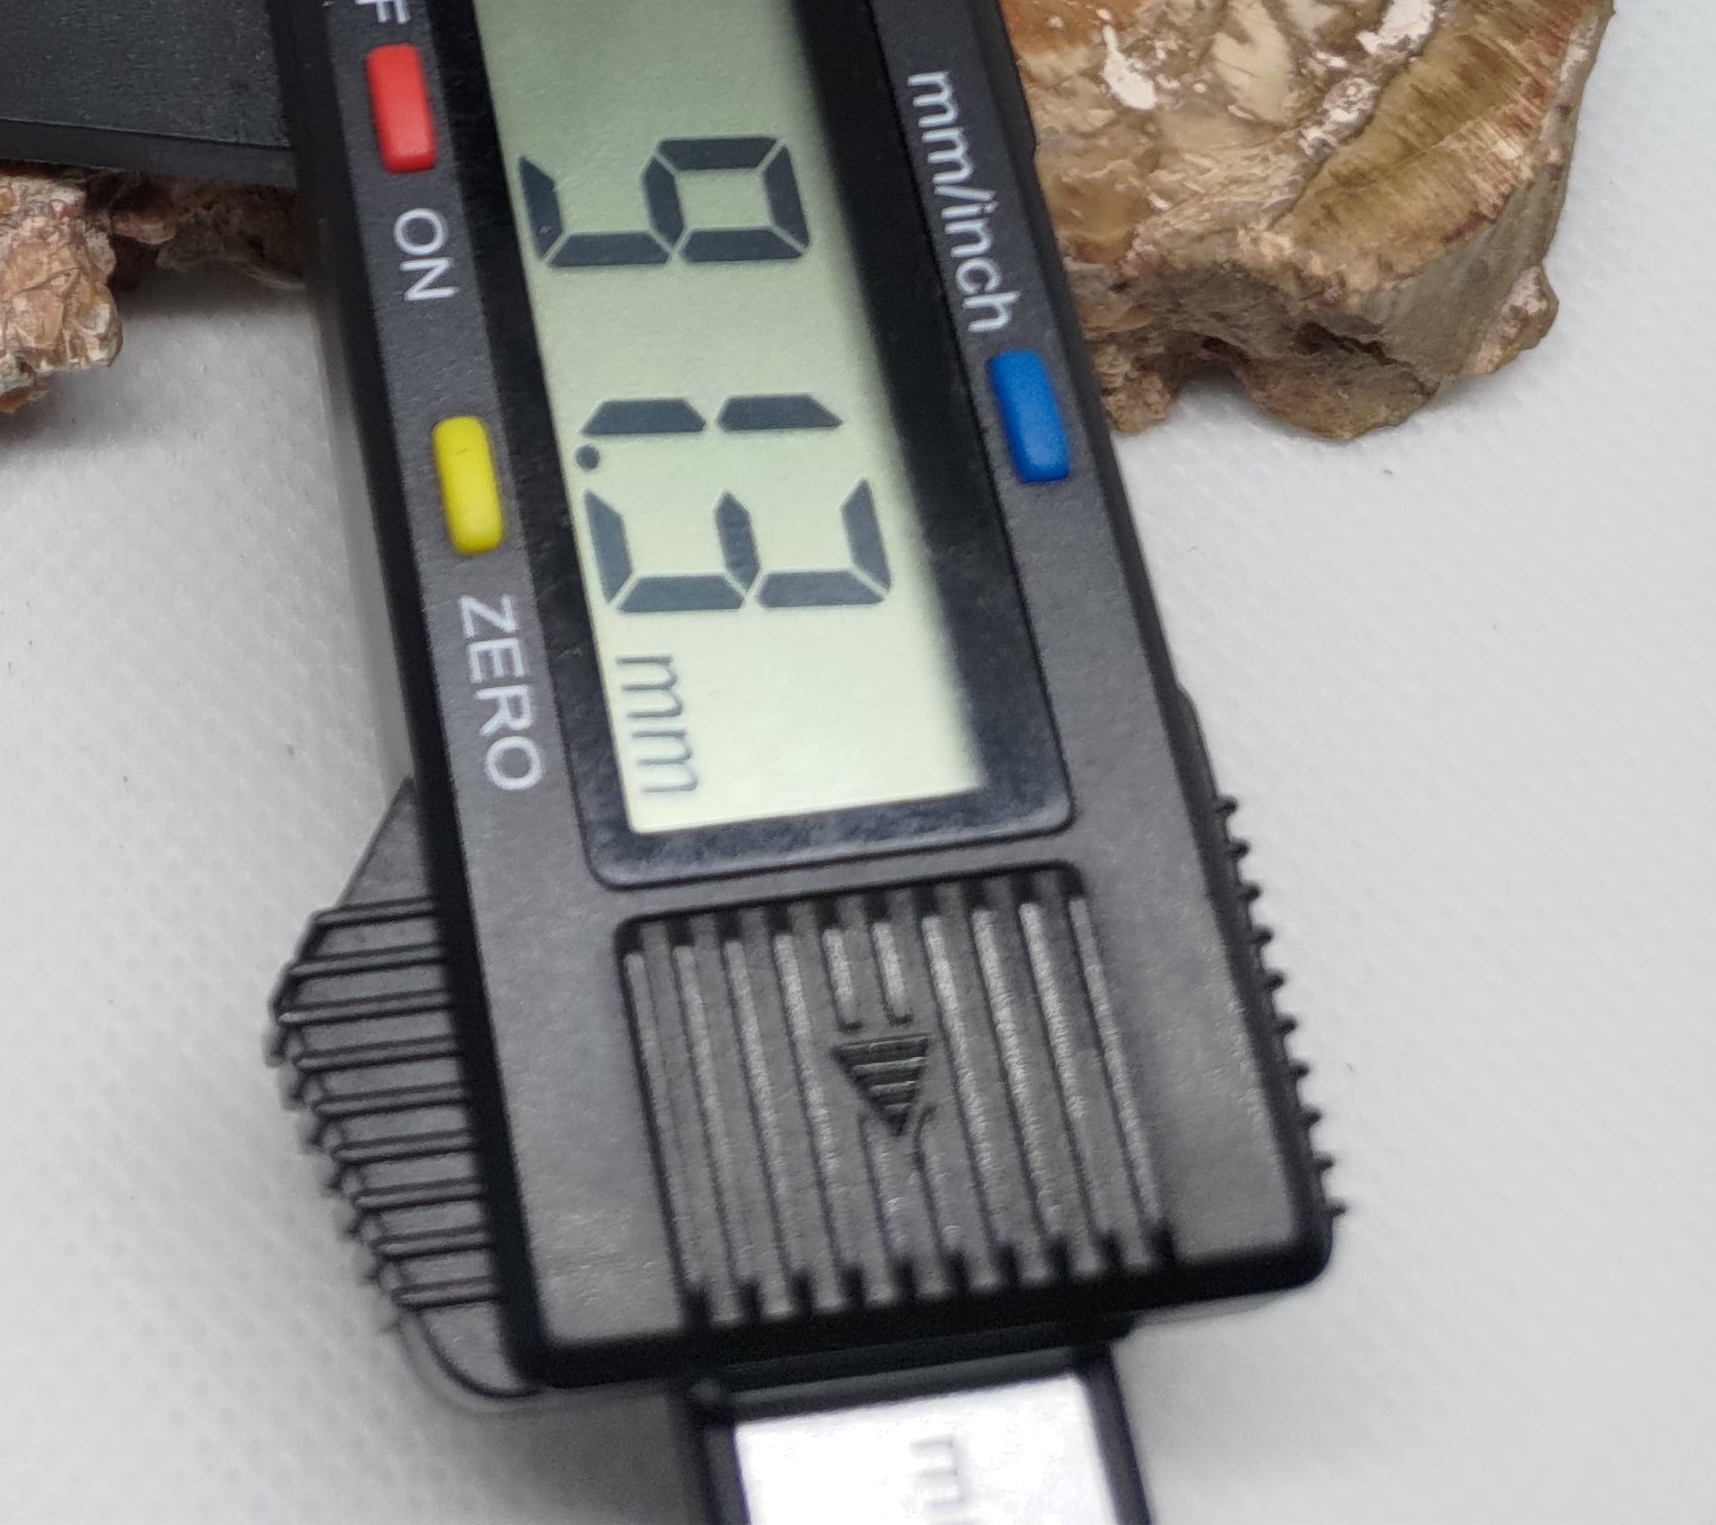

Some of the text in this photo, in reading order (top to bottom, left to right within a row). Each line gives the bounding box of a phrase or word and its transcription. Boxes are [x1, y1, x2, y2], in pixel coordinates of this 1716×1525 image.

[396, 208, 455, 302] ON
[908, 71, 1020, 333] mm/inch
[460, 595, 542, 790] ZERO
[616, 654, 698, 795] mm
